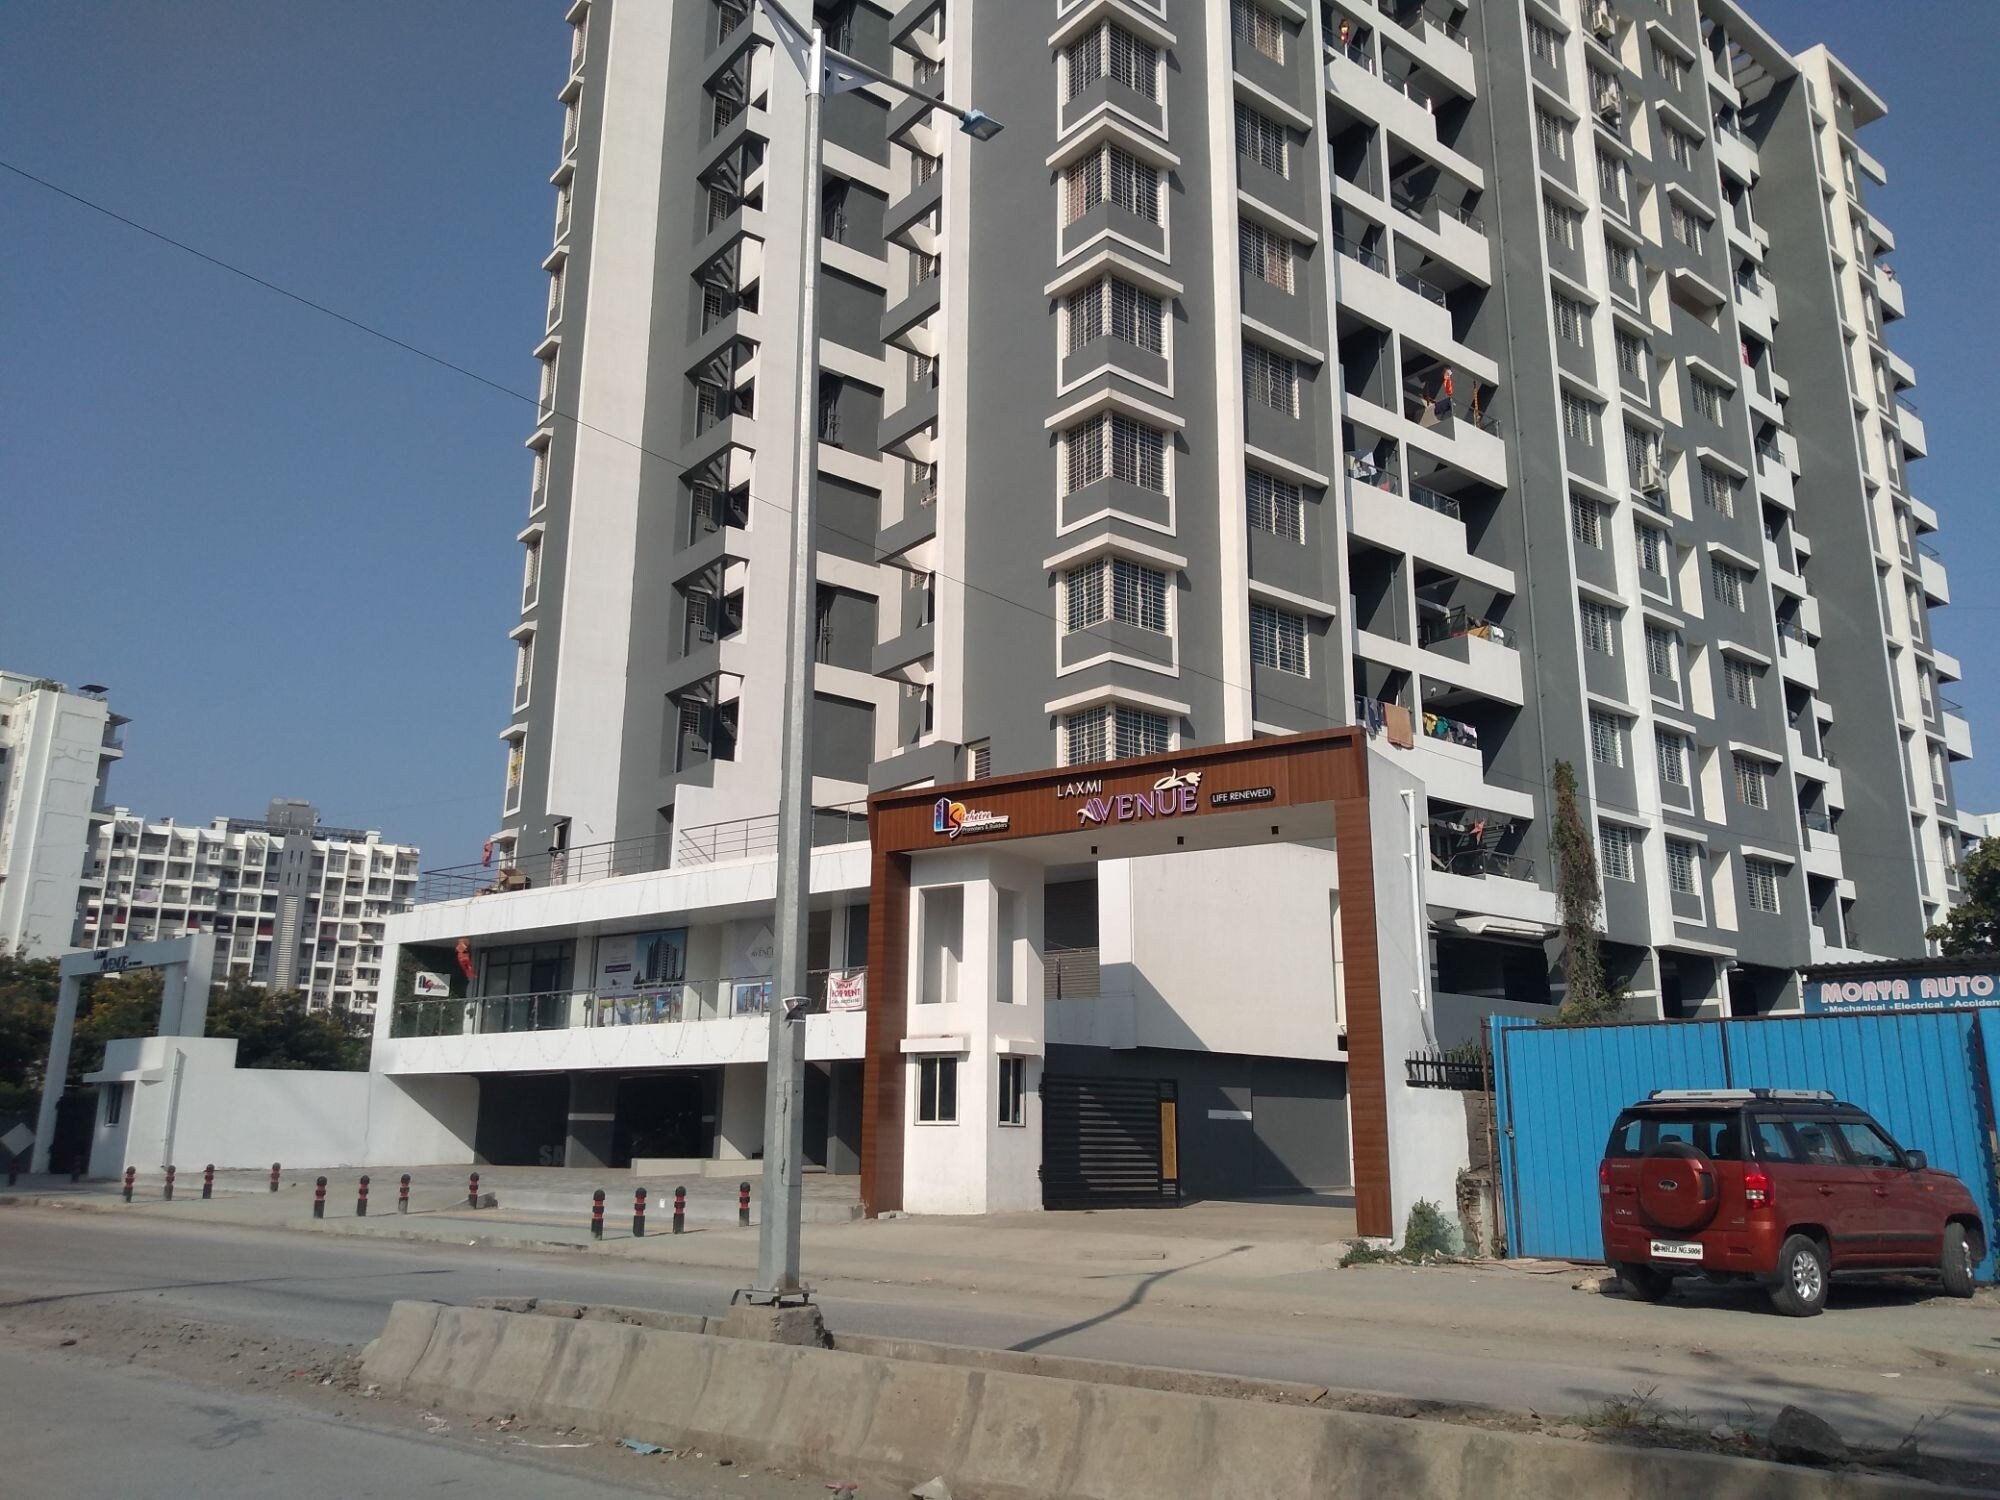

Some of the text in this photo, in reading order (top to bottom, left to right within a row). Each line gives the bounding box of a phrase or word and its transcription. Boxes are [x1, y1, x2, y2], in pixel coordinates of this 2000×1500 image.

[1057, 779, 1102, 797] LAXMI
[1212, 788, 1272, 803] LIFE RENEWED!
[1077, 785, 1198, 824] AVENUE
[1821, 975, 1994, 1003] MORYA AUTO
[1829, 1003, 1886, 1013] Mechanical
[1894, 1001, 1944, 1010] Electrical
